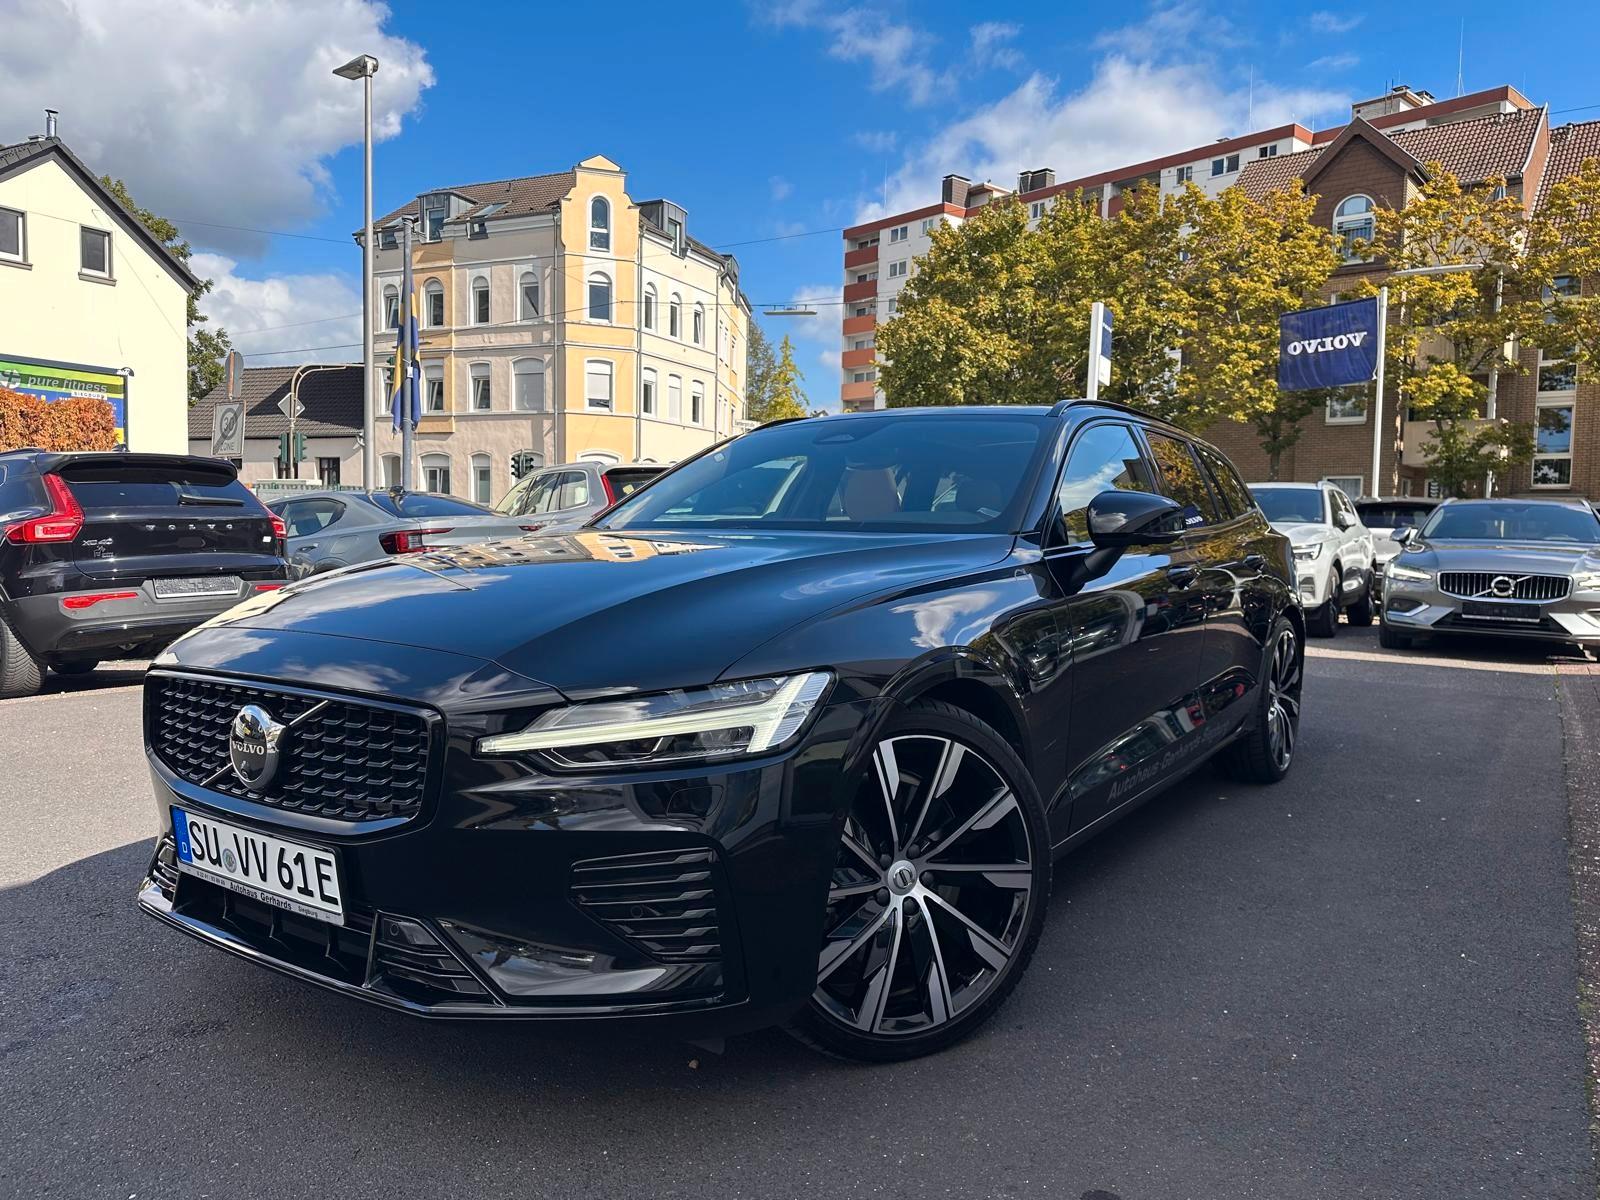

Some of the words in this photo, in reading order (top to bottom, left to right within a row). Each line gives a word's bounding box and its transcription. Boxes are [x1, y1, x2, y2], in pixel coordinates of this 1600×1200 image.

[27, 375, 60, 388] pure
[63, 378, 108, 393] fitness
[223, 416, 236, 431] 30
[145, 523, 234, 532] VOLVO
[232, 740, 265, 756] VOLVO
[181, 841, 188, 854] D
[188, 820, 223, 868] SU
[232, 832, 268, 883] VV
[276, 846, 339, 906] 61E
[229, 882, 258, 900] Autohaus
[260, 893, 292, 910] Gerhards
